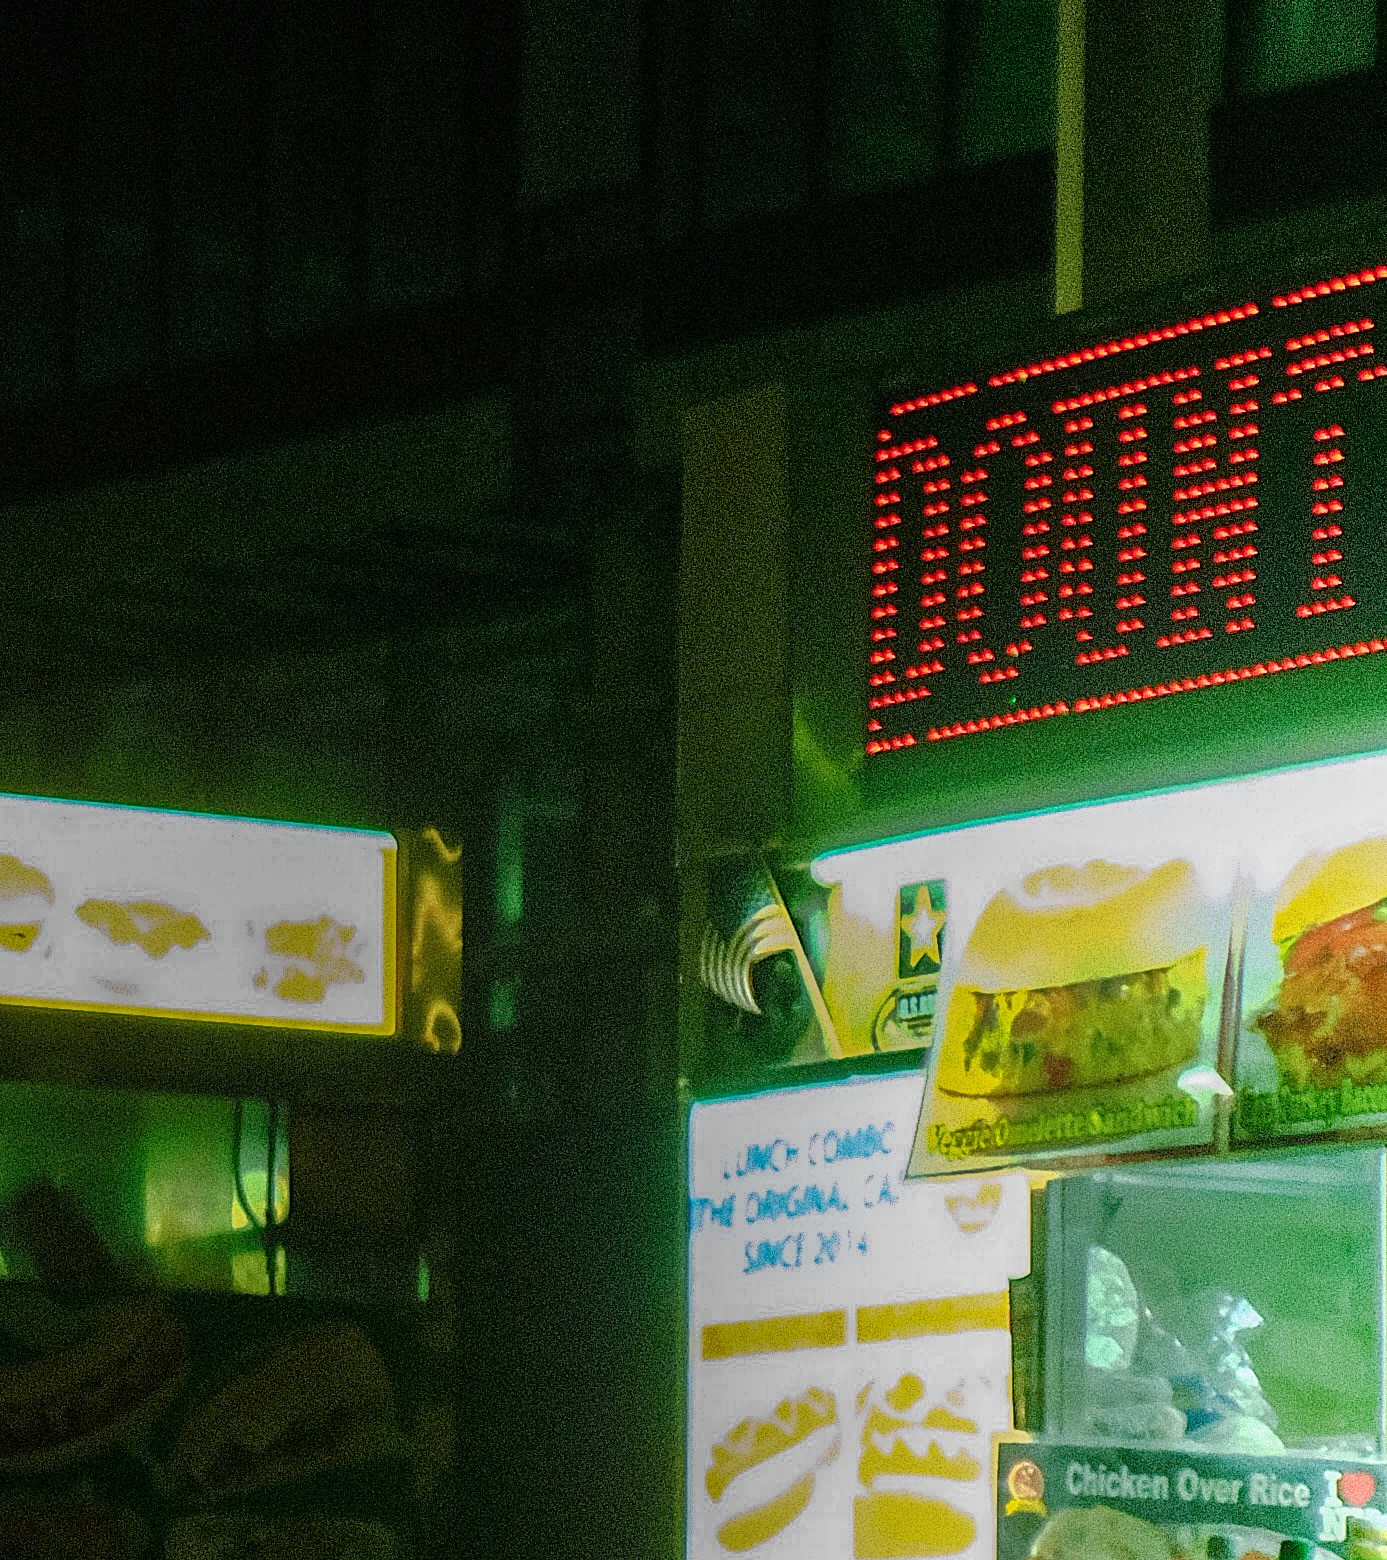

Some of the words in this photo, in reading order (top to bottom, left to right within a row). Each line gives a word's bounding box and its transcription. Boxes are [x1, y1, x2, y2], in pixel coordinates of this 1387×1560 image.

[1087, 1093, 1199, 1137] Sandwich
[1065, 1462, 1170, 1502] Chicken
[1176, 1467, 1244, 1505] Over
[1250, 1472, 1312, 1509] Rice
